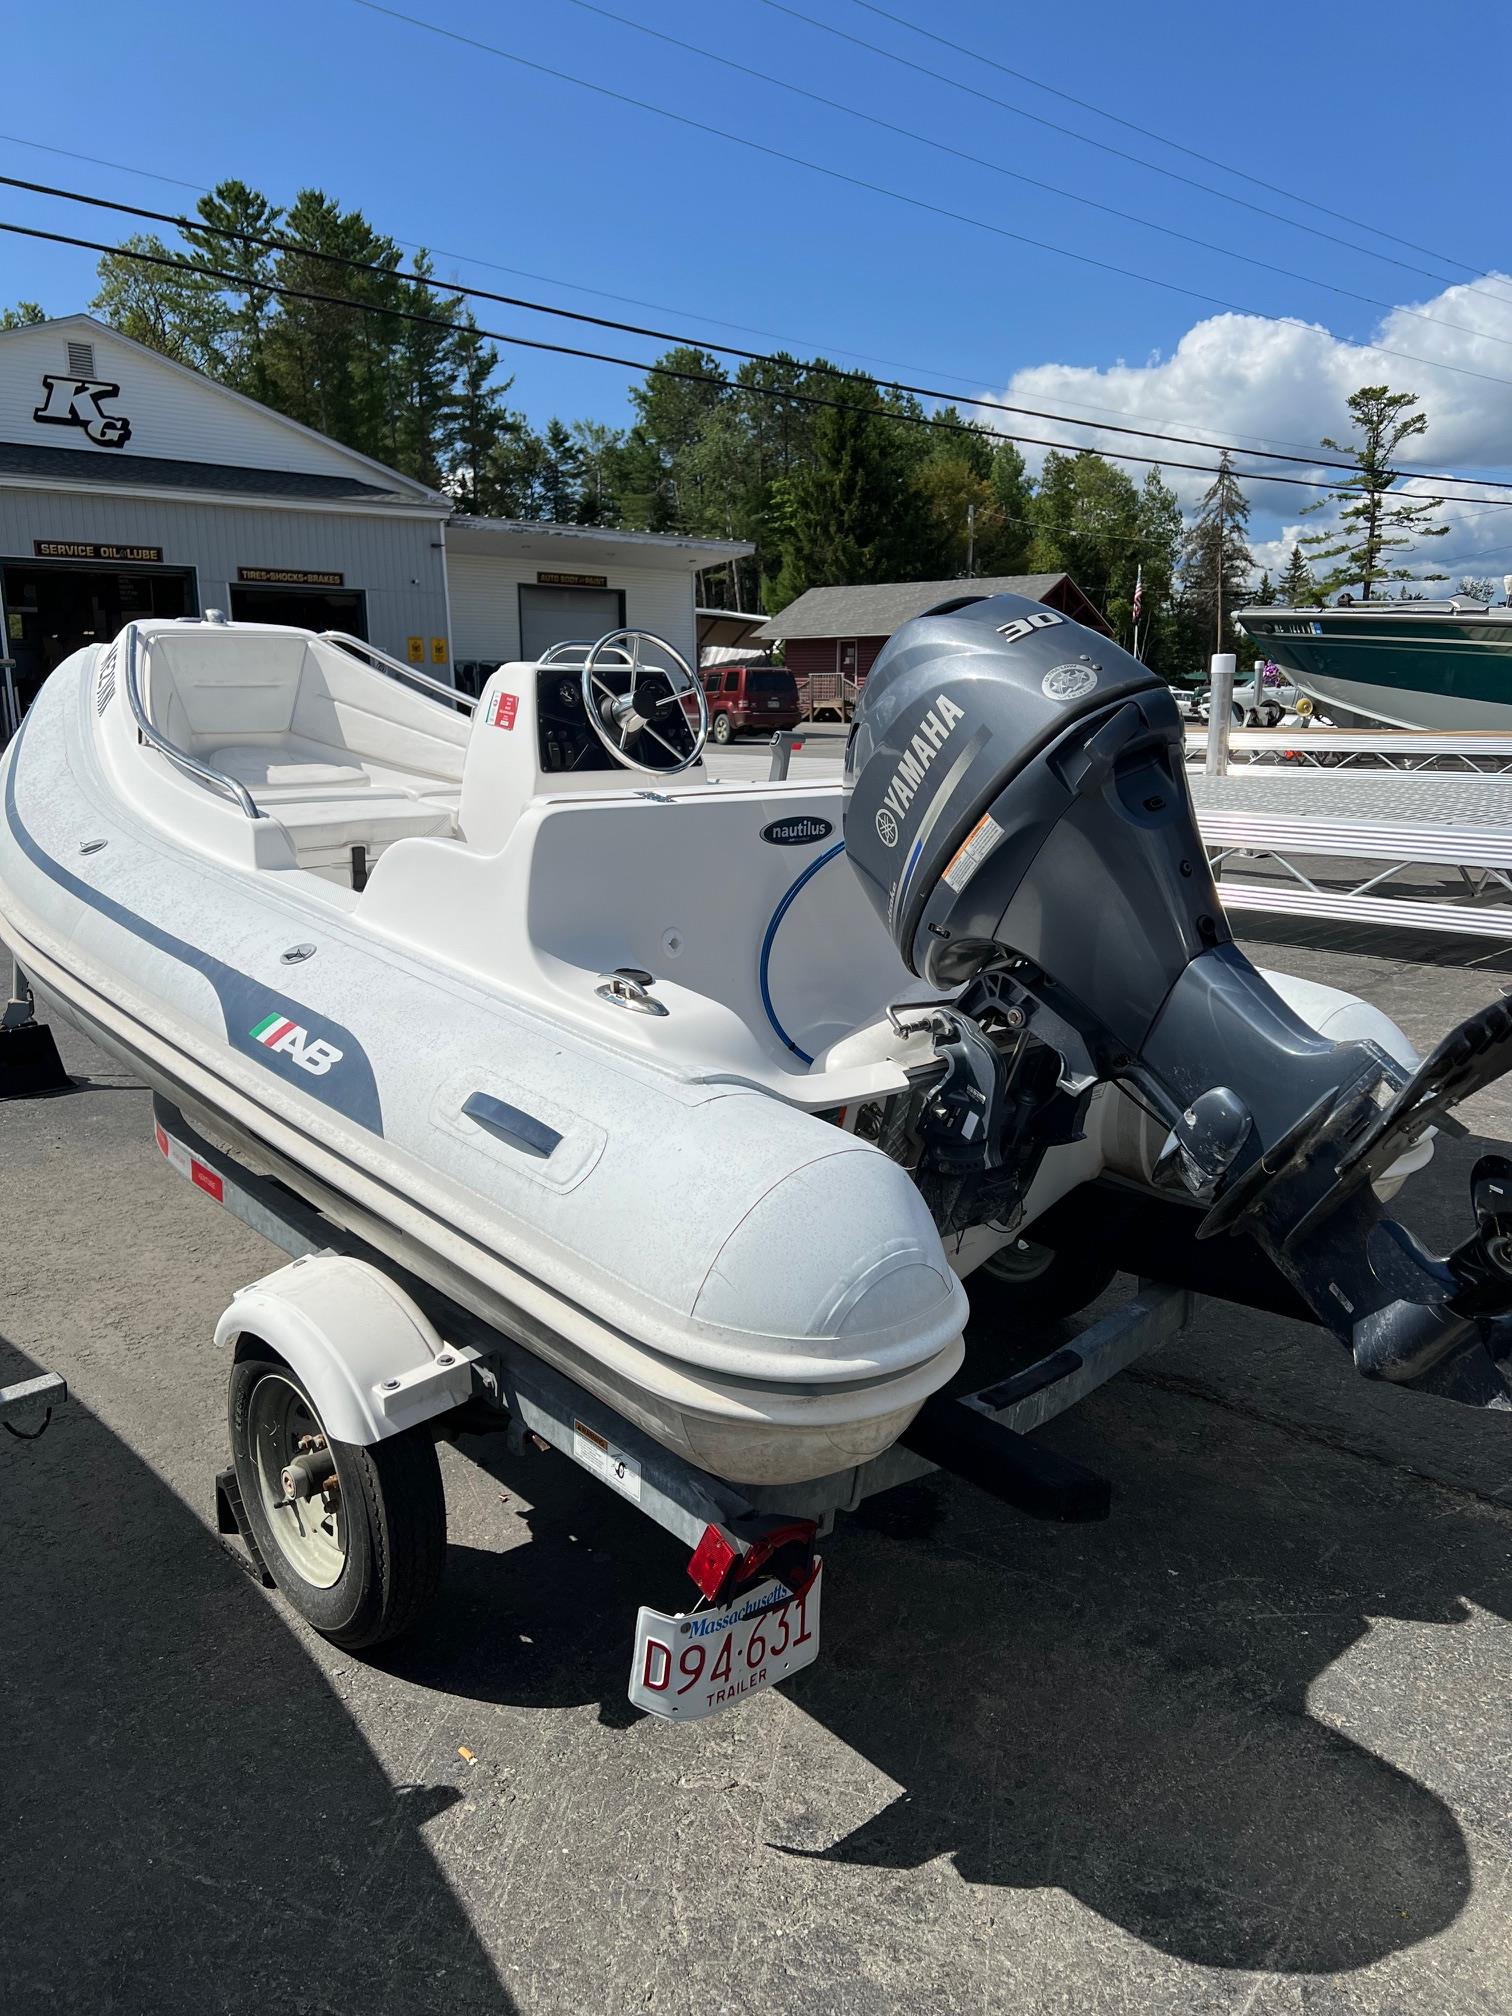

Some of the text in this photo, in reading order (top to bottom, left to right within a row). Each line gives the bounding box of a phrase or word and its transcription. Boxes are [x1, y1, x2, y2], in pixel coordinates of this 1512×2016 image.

[40, 544, 95, 556] SERVICE
[100, 547, 120, 558] OIL
[127, 549, 158, 560] LUBE
[307, 574, 341, 584] BRAKES
[996, 612, 1064, 643] 30
[883, 693, 965, 820] YAMAHA
[772, 820, 826, 838] nautilus
[269, 1025, 344, 1076] AB
[688, 1583, 788, 1639] Massachusetts
[706, 1668, 767, 1707] TRAILER
